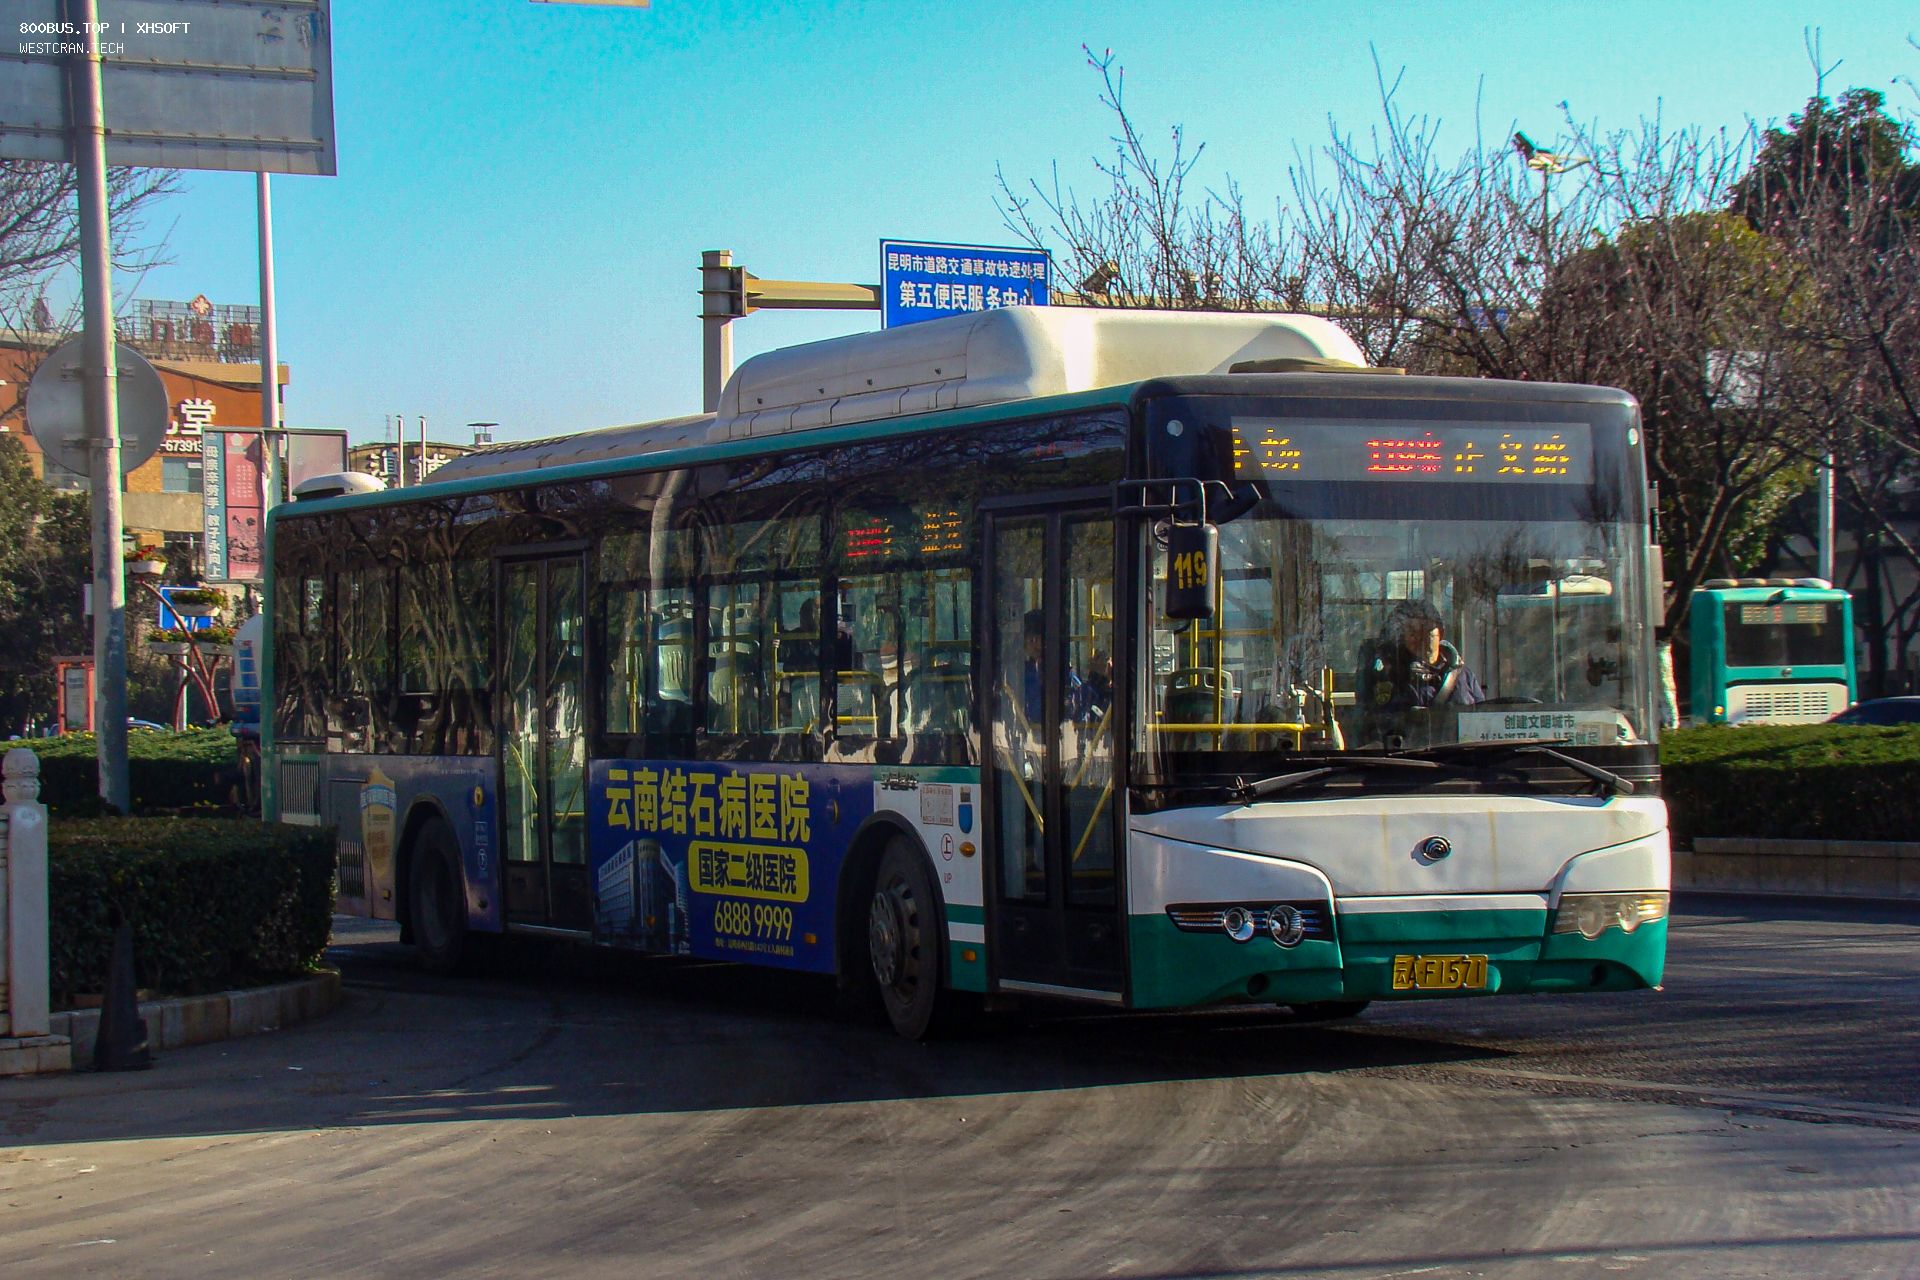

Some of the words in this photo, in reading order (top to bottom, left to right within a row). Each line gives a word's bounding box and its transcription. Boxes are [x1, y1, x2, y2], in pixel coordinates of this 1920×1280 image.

[887, 252, 1045, 280] 昆明市道路交通事故快速处理
[899, 280, 1035, 312] 第五便民服务中心
[1173, 550, 1207, 590] 119
[1504, 713, 1575, 729] 创建文明城市
[605, 766, 811, 844] 云南结石病医院
[698, 847, 797, 895] 国家二级医院
[943, 872, 953, 884] UP
[714, 900, 752, 937] 6888
[753, 903, 793, 941] 9999
